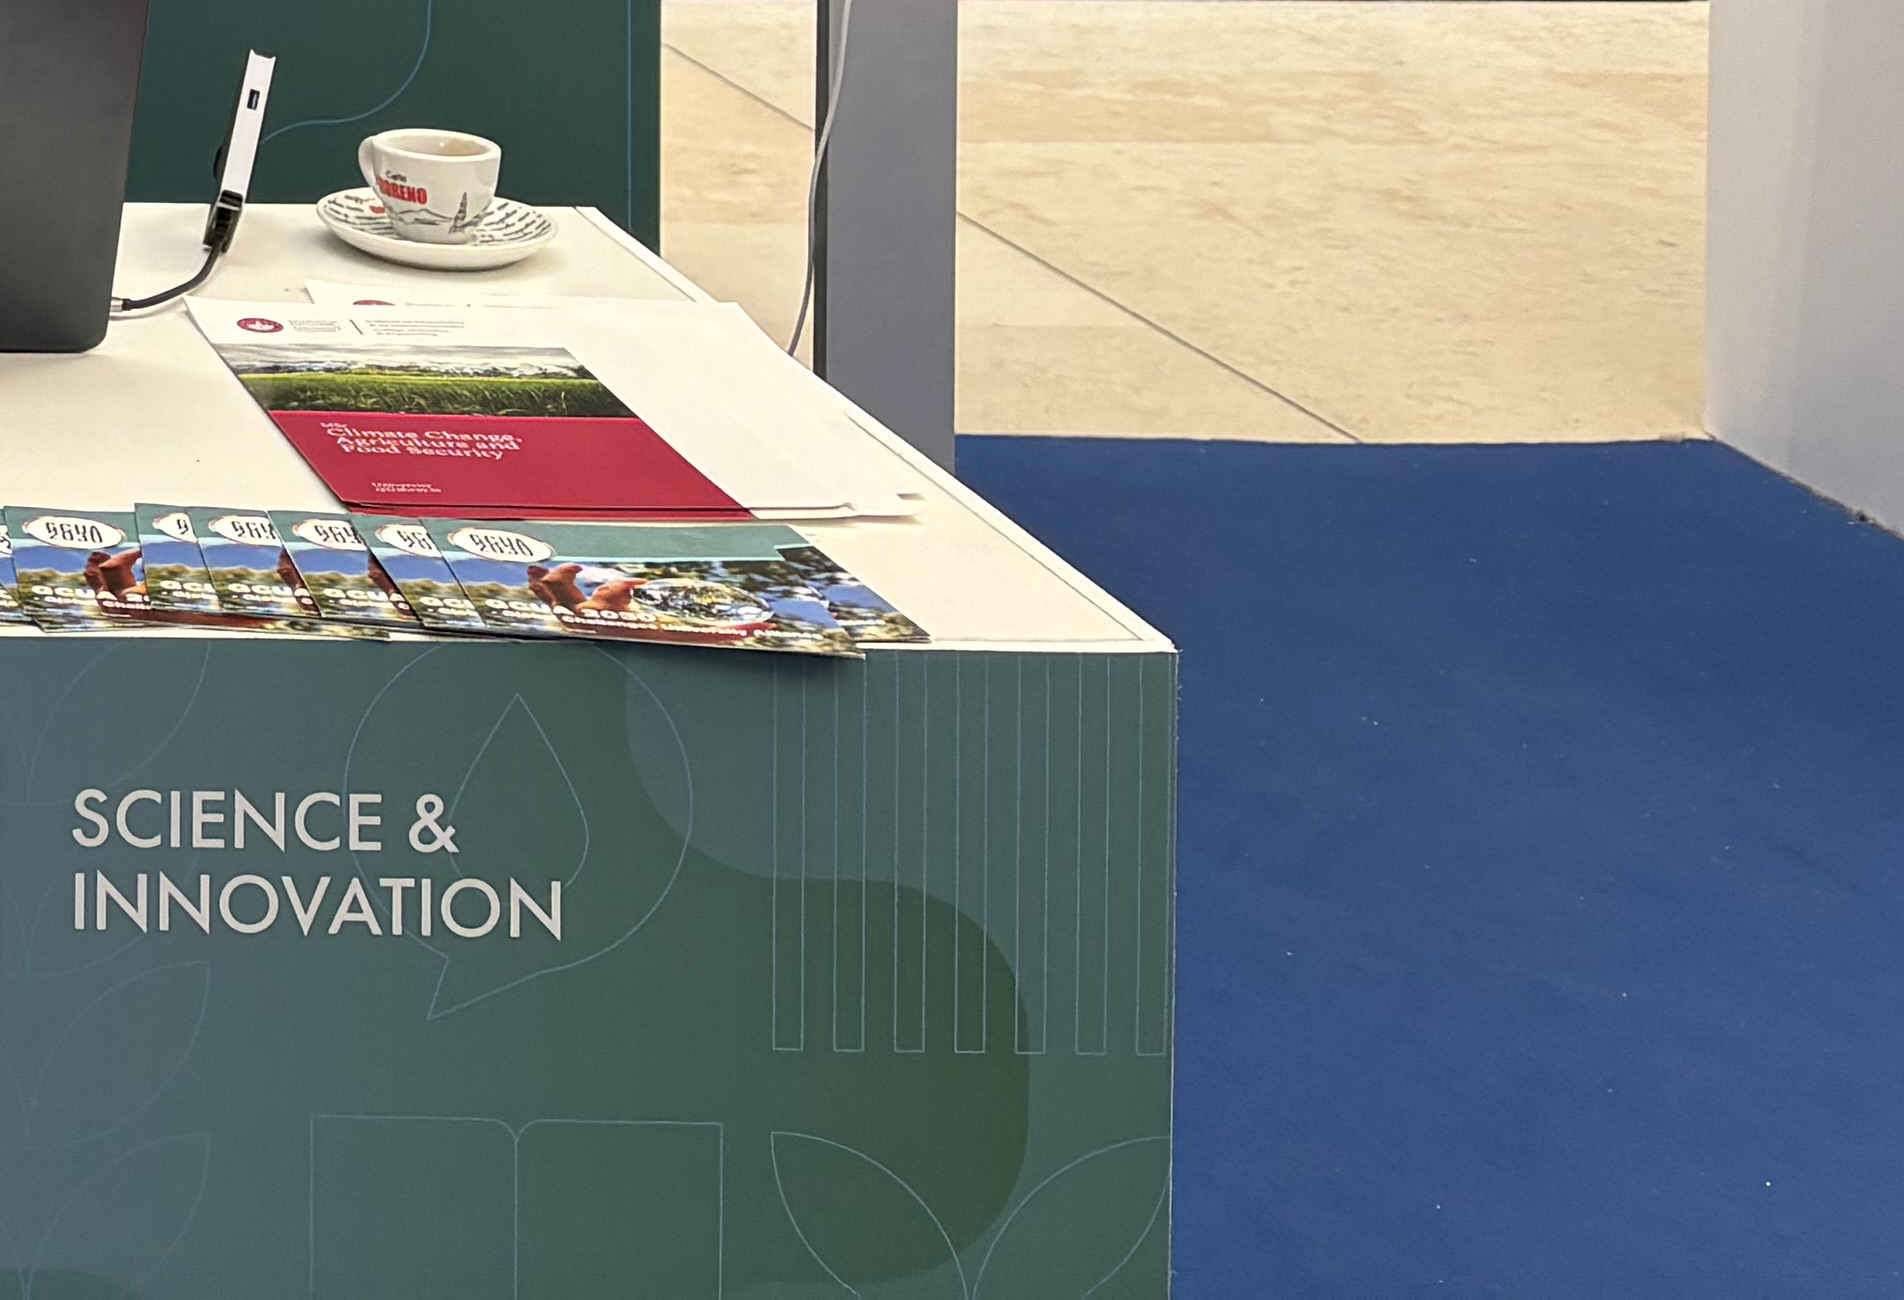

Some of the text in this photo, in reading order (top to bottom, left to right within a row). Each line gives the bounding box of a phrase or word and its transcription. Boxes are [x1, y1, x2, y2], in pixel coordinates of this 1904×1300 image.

[326, 427, 420, 440] Climate
[336, 436, 521, 451] Agriculture and
[343, 443, 505, 461] Food Security
[484, 598, 575, 617] GCUA
[72, 789, 459, 852] SCIENCE &
[75, 870, 561, 940] INNOVATION
